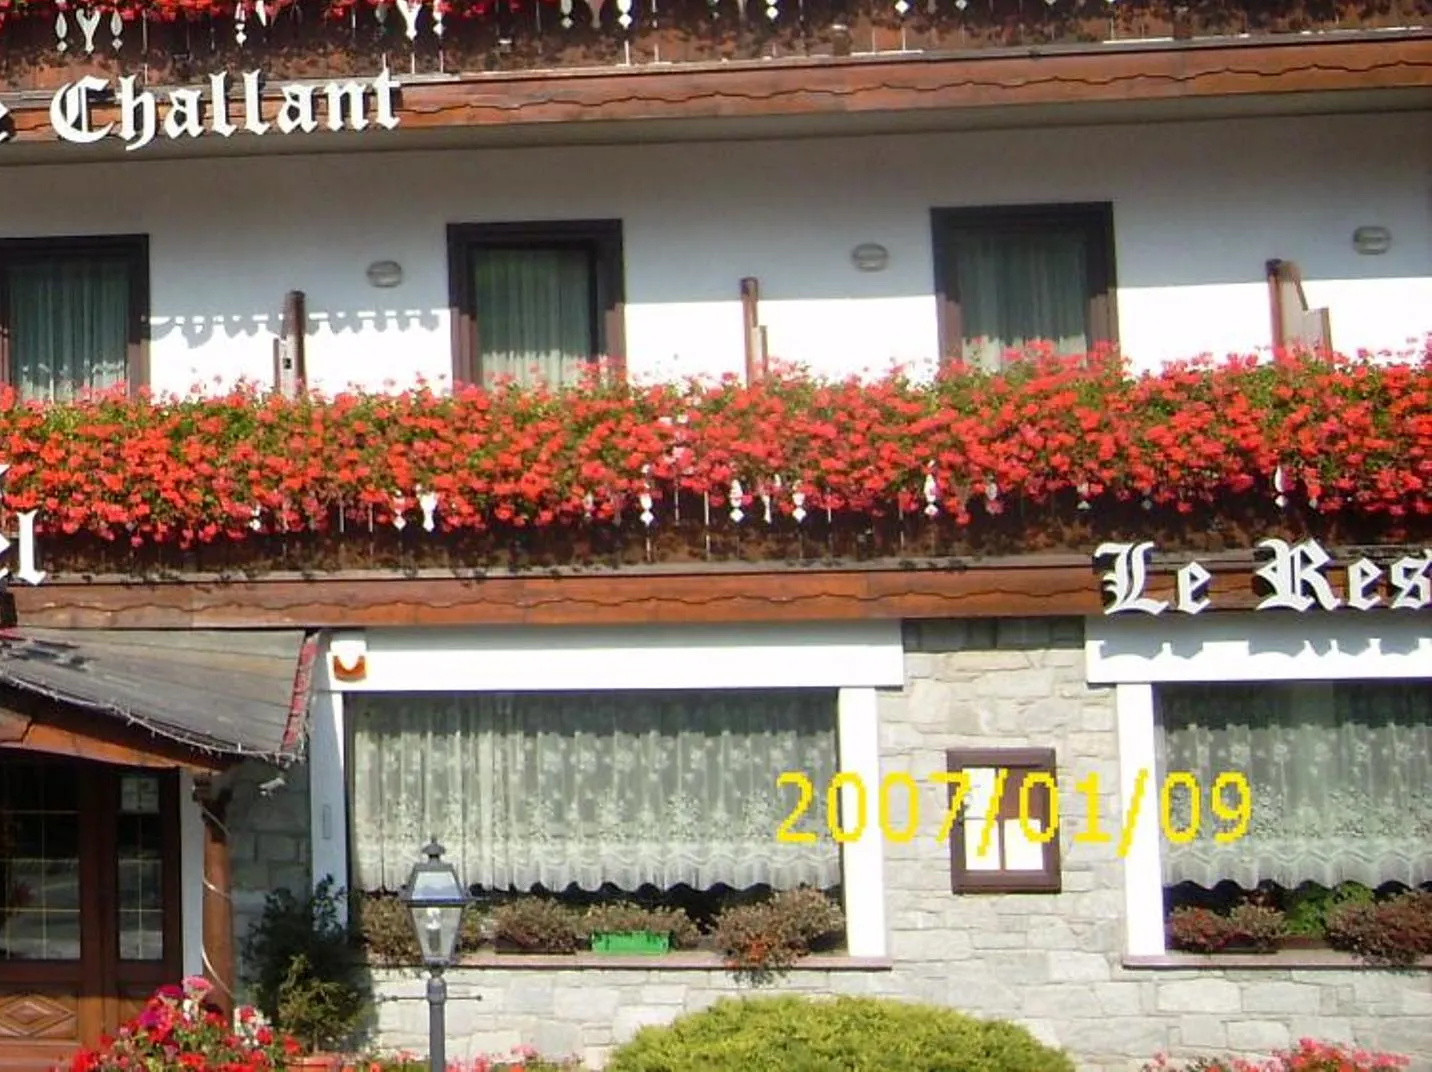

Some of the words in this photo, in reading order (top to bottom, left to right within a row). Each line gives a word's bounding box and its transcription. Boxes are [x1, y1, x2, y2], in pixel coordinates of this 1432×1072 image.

[50, 68, 402, 150] Challant
[1094, 540, 1212, 615] Le
[1255, 537, 1432, 612] Res
